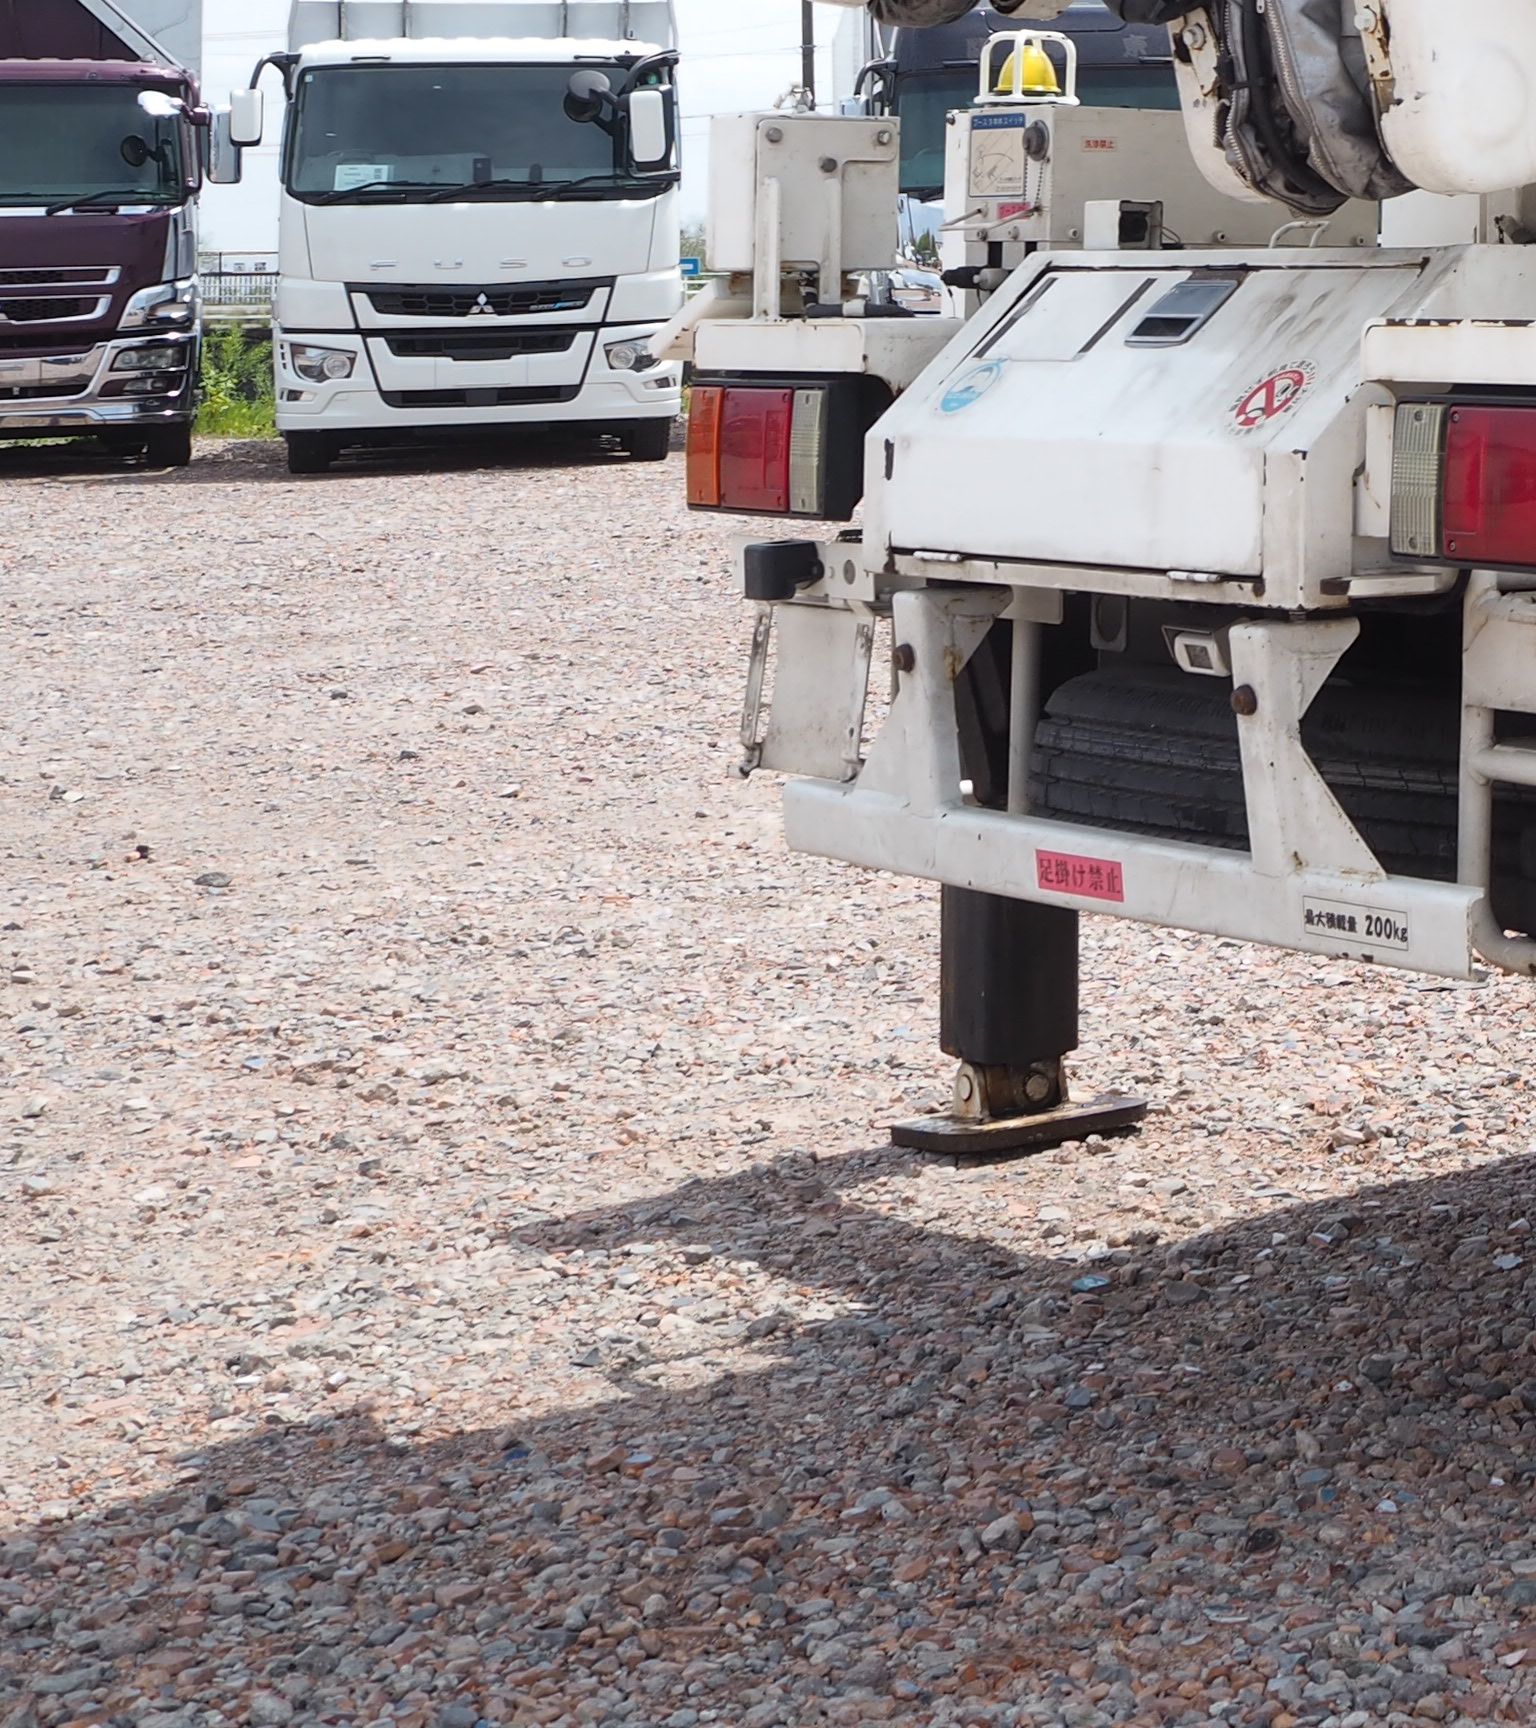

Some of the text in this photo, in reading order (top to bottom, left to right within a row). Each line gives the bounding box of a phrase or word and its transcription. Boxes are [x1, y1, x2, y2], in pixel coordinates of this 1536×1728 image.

[369, 255, 592, 271] FUSO
[1039, 858, 1121, 894] 足掛け禁止
[1365, 914, 1408, 942] 200kg
